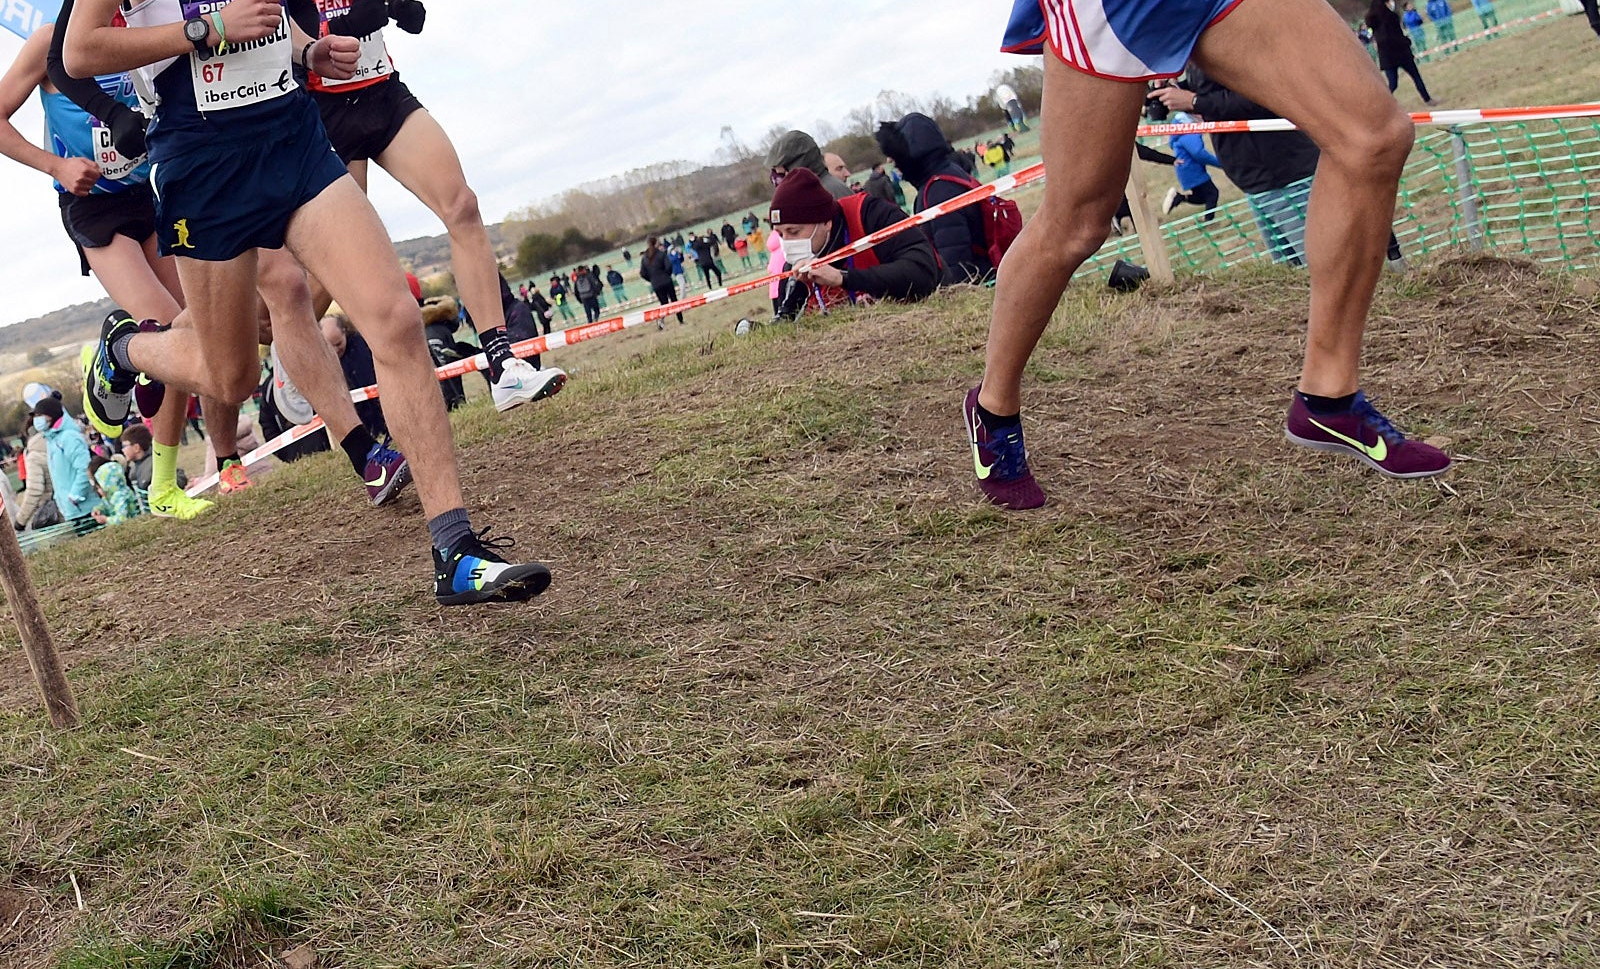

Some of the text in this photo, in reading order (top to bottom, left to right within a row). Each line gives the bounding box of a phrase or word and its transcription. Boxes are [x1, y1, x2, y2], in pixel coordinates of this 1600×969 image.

[202, 62, 225, 83] 67
[204, 81, 267, 103] iberCaja
[101, 151, 116, 163] 90
